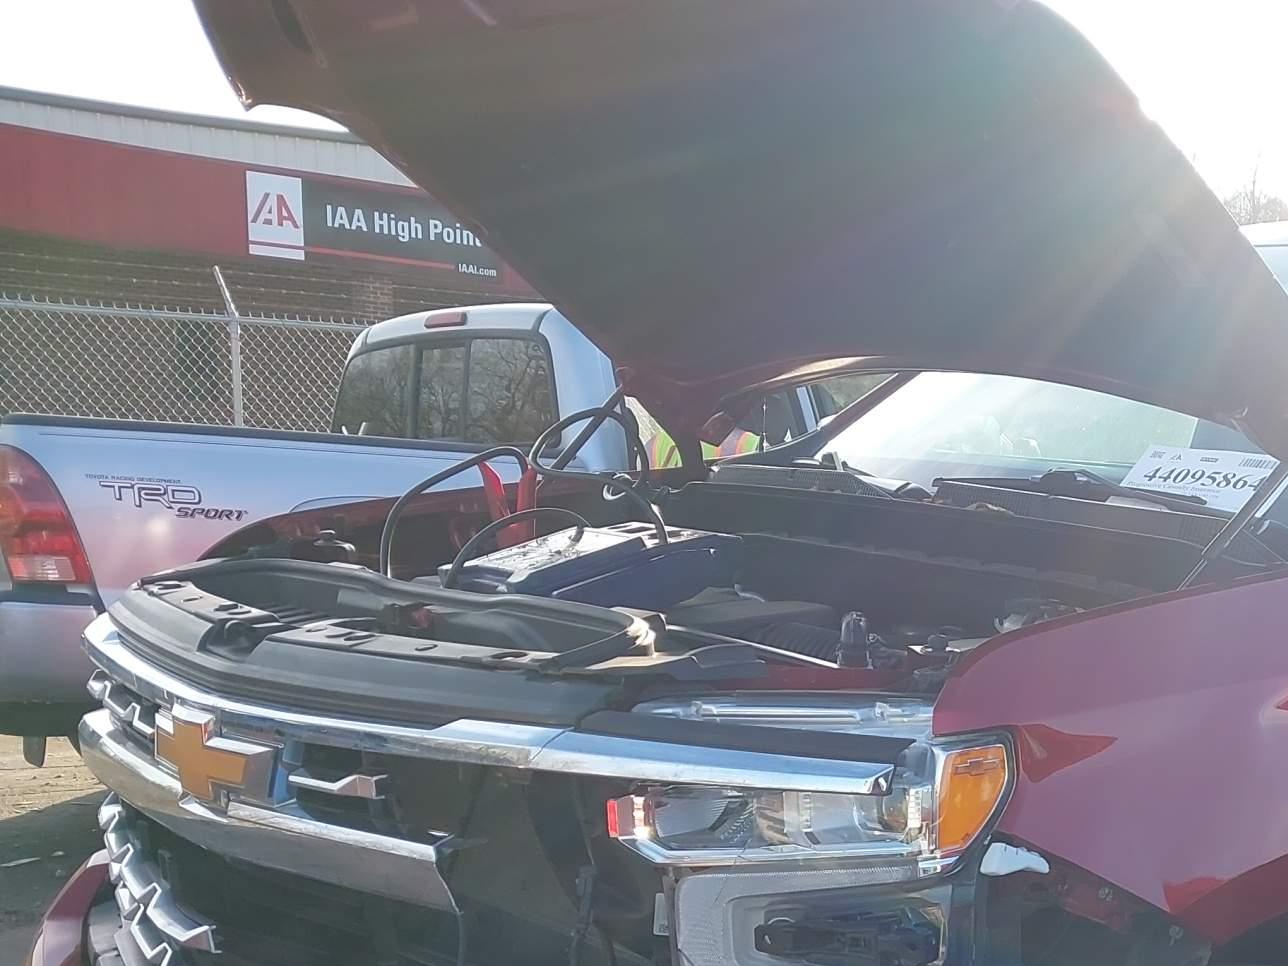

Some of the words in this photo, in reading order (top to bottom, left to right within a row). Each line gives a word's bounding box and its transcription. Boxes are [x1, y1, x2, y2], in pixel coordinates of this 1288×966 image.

[326, 204, 368, 232] IAA
[374, 211, 423, 242] High
[1143, 466, 1268, 492] 44095864
[99, 481, 202, 510] TRD
[175, 506, 245, 521] SPORT
